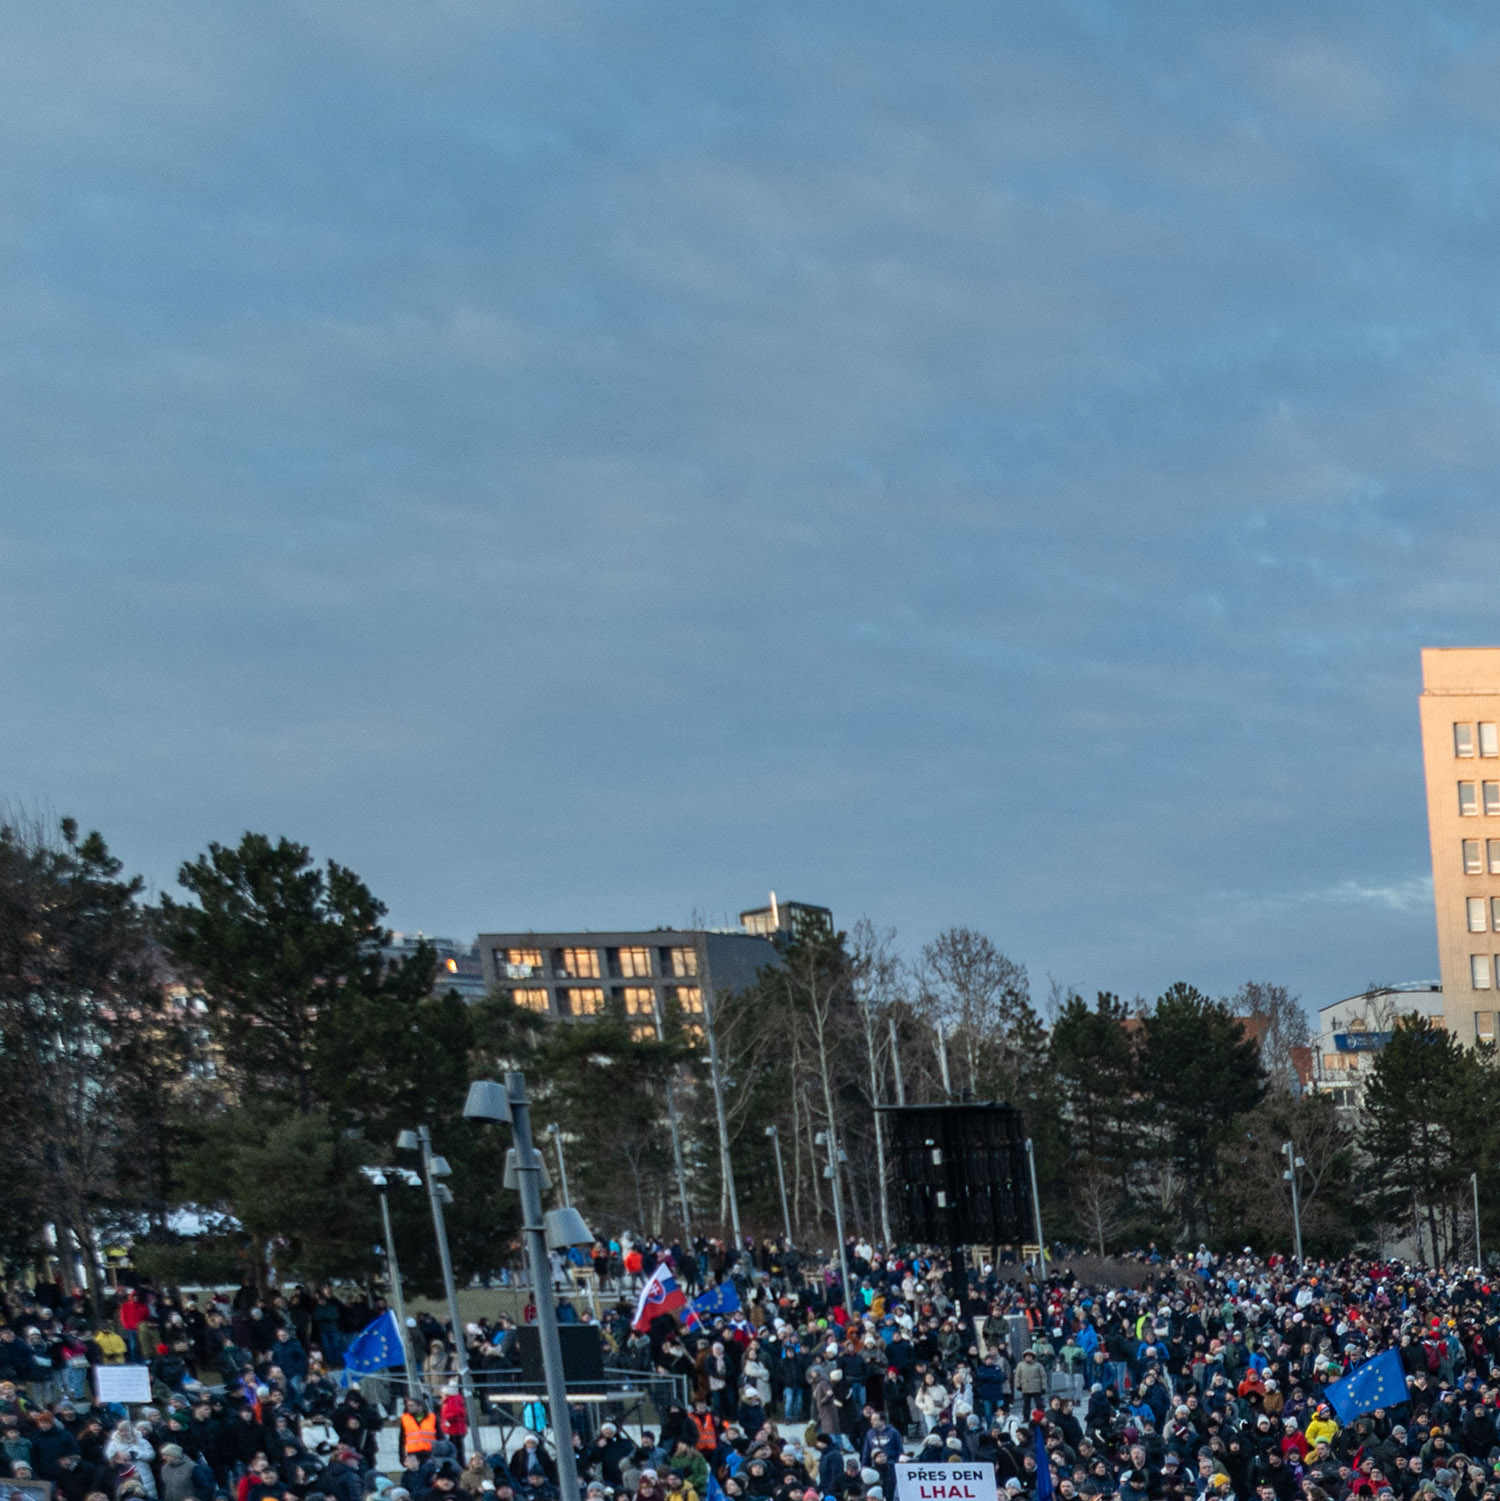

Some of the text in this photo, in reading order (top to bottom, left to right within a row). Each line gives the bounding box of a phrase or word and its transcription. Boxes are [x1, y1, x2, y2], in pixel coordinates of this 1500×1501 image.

[907, 1468, 983, 1481] PŘES DEN
[920, 1485, 976, 1498] LHAL
